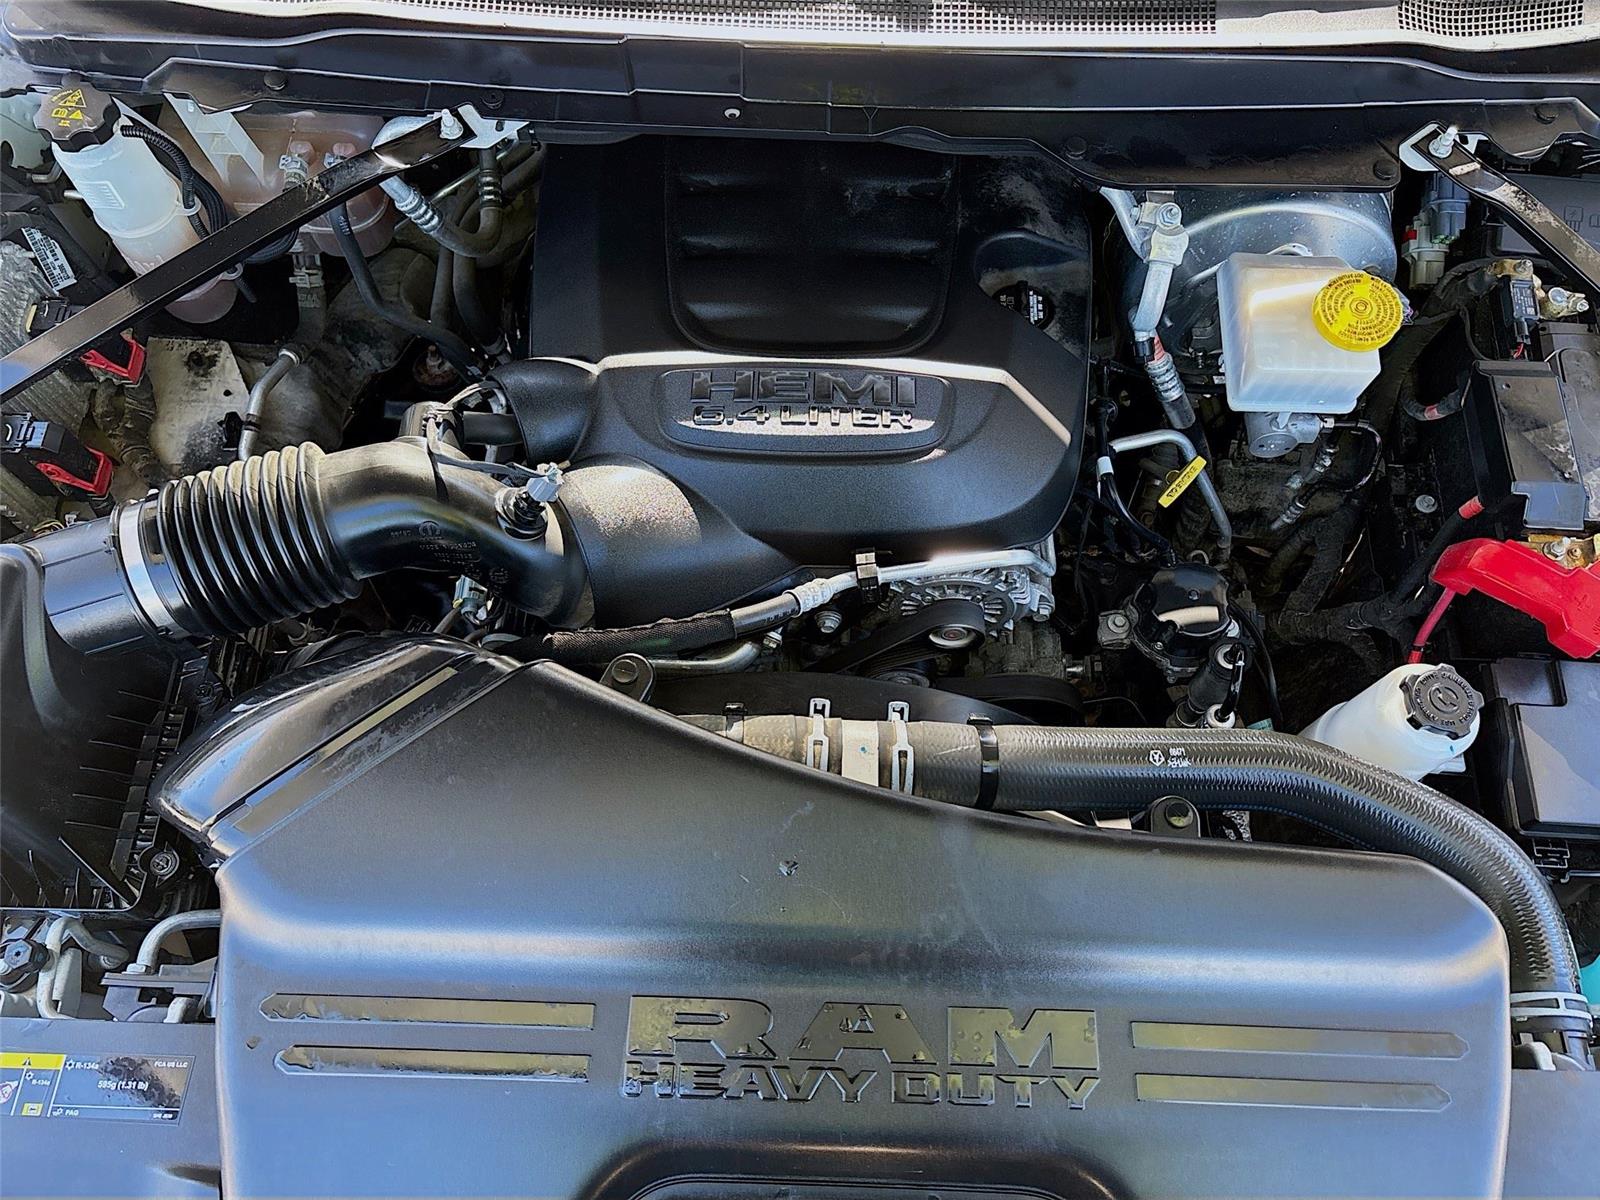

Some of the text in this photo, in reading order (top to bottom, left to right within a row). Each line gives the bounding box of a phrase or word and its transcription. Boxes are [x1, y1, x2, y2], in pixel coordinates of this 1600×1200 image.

[690, 370, 917, 408] HEMI
[692, 404, 913, 429] 6.4 LITER
[626, 994, 1100, 1071] RAM
[154, 1060, 167, 1068] FCA
[174, 1061, 188, 1069] LLC
[623, 1060, 1100, 1111] HEAVY DUTY
